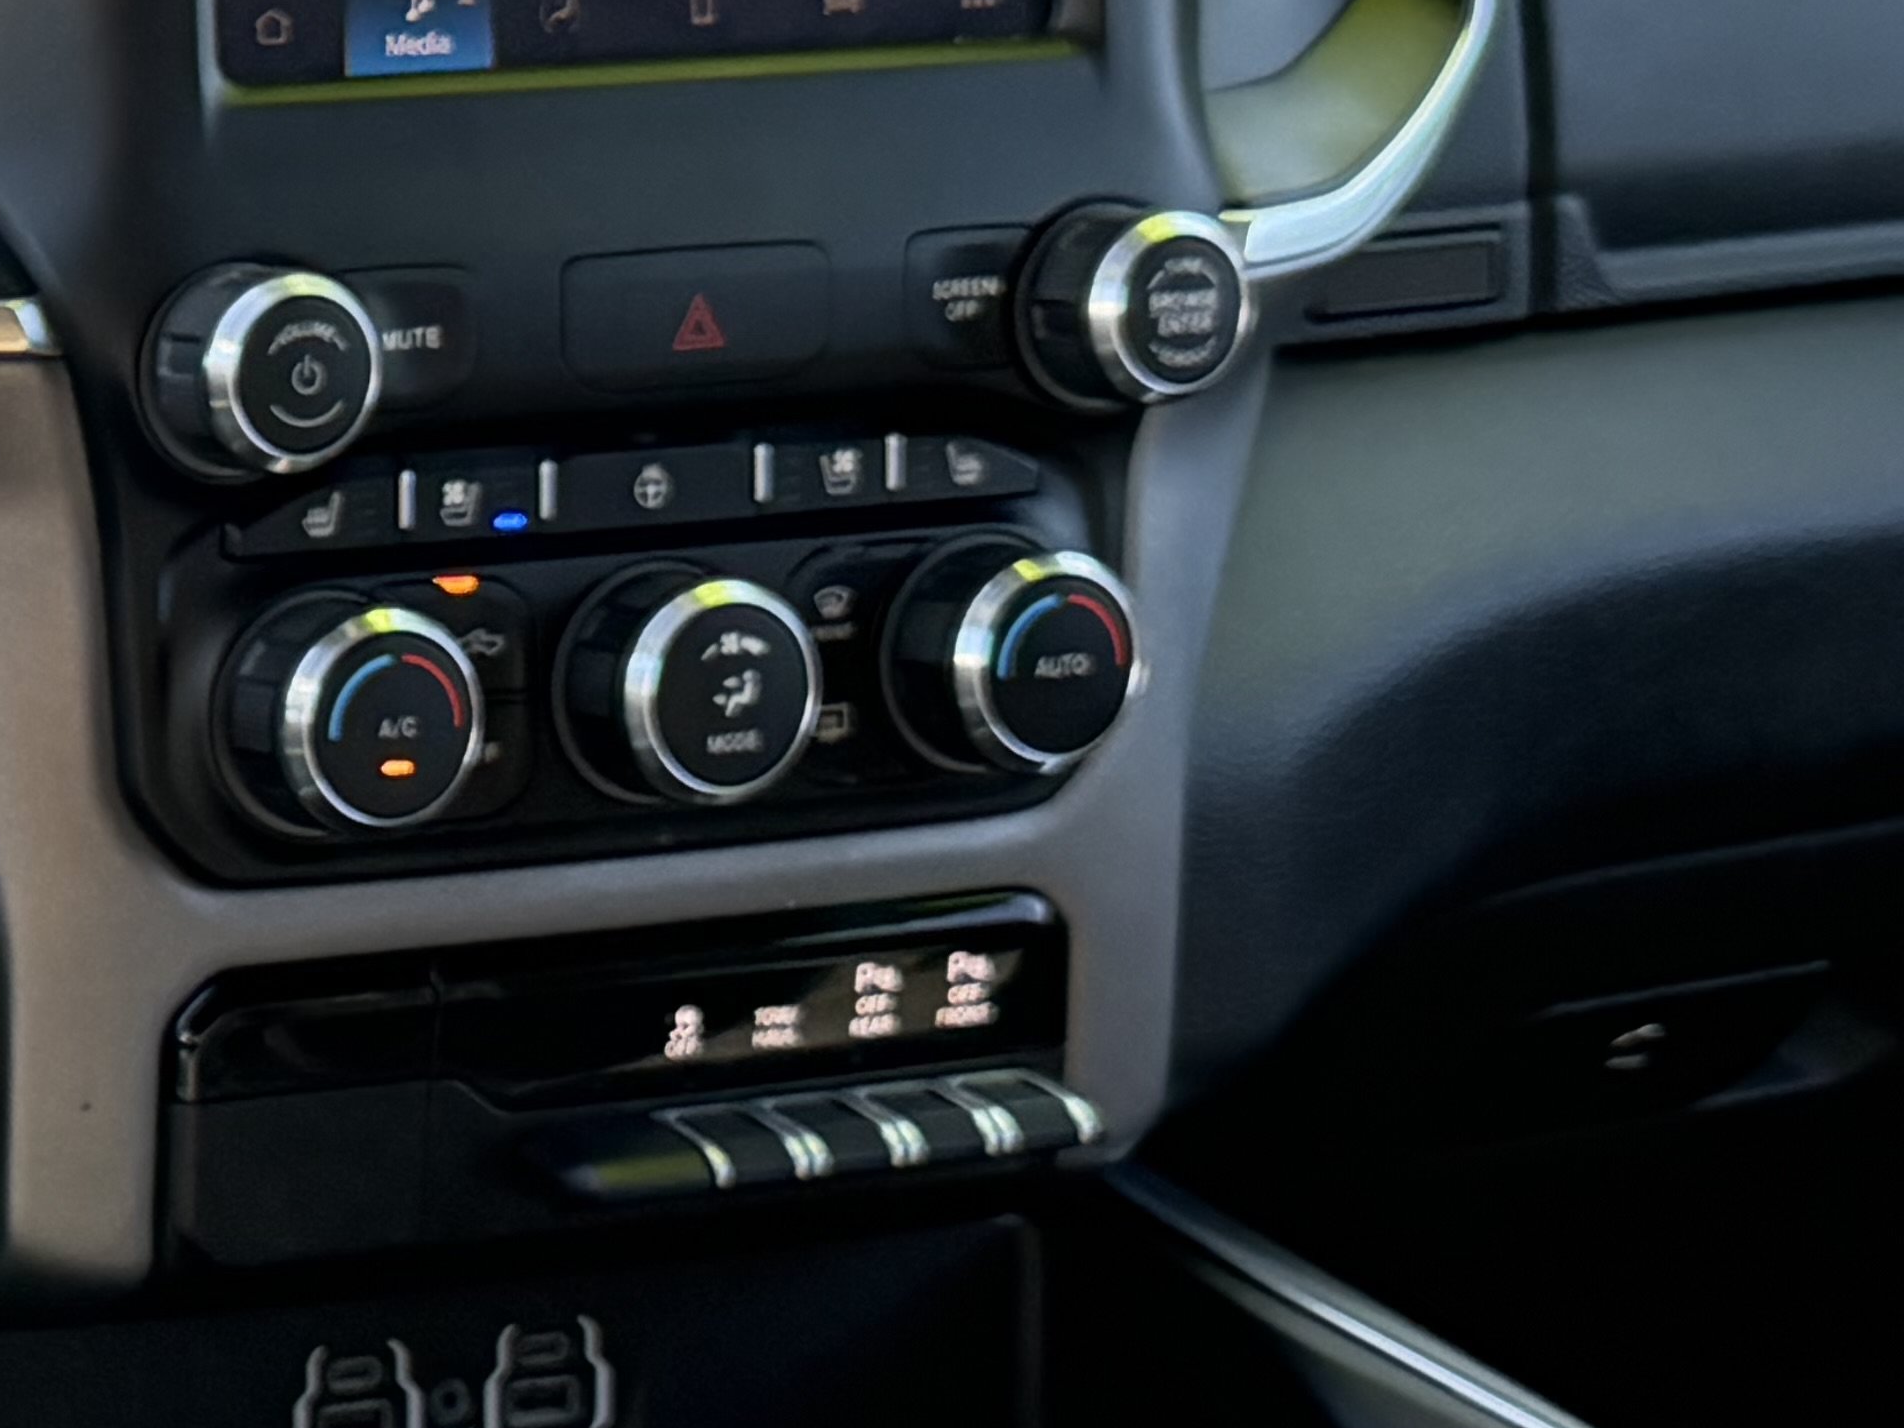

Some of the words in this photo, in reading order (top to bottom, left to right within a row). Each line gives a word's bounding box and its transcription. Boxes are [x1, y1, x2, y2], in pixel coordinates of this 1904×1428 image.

[385, 31, 453, 57] Media
[382, 325, 441, 351] MUTE
[1034, 652, 1089, 679] AUTO
[378, 715, 418, 739] A/C
[706, 731, 762, 753] MODE
